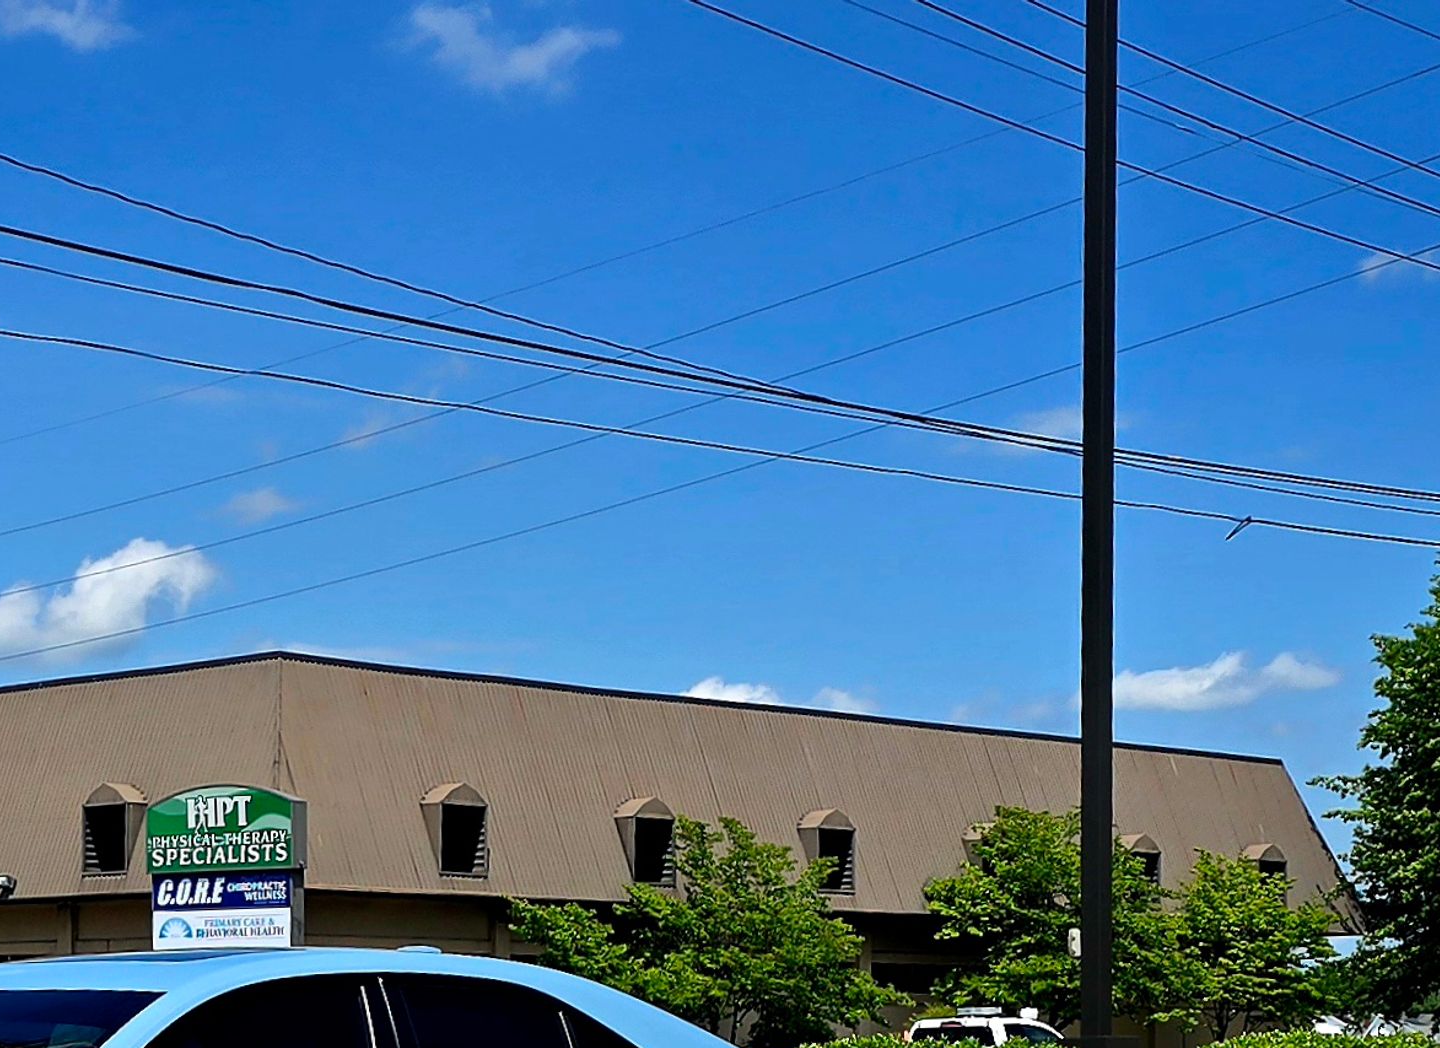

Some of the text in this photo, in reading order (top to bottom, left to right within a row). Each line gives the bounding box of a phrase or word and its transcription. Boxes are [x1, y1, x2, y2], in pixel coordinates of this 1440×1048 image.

[152, 830, 287, 849] PHYSICAL THERAPY
[151, 843, 288, 867] SPECIALISTS
[227, 880, 287, 893] CHIROPRACTIC
[244, 890, 287, 901] WELLNESS
[204, 918, 241, 927] PRIMARY
[243, 917, 265, 927] CARE
[250, 926, 285, 937] HEALTH
